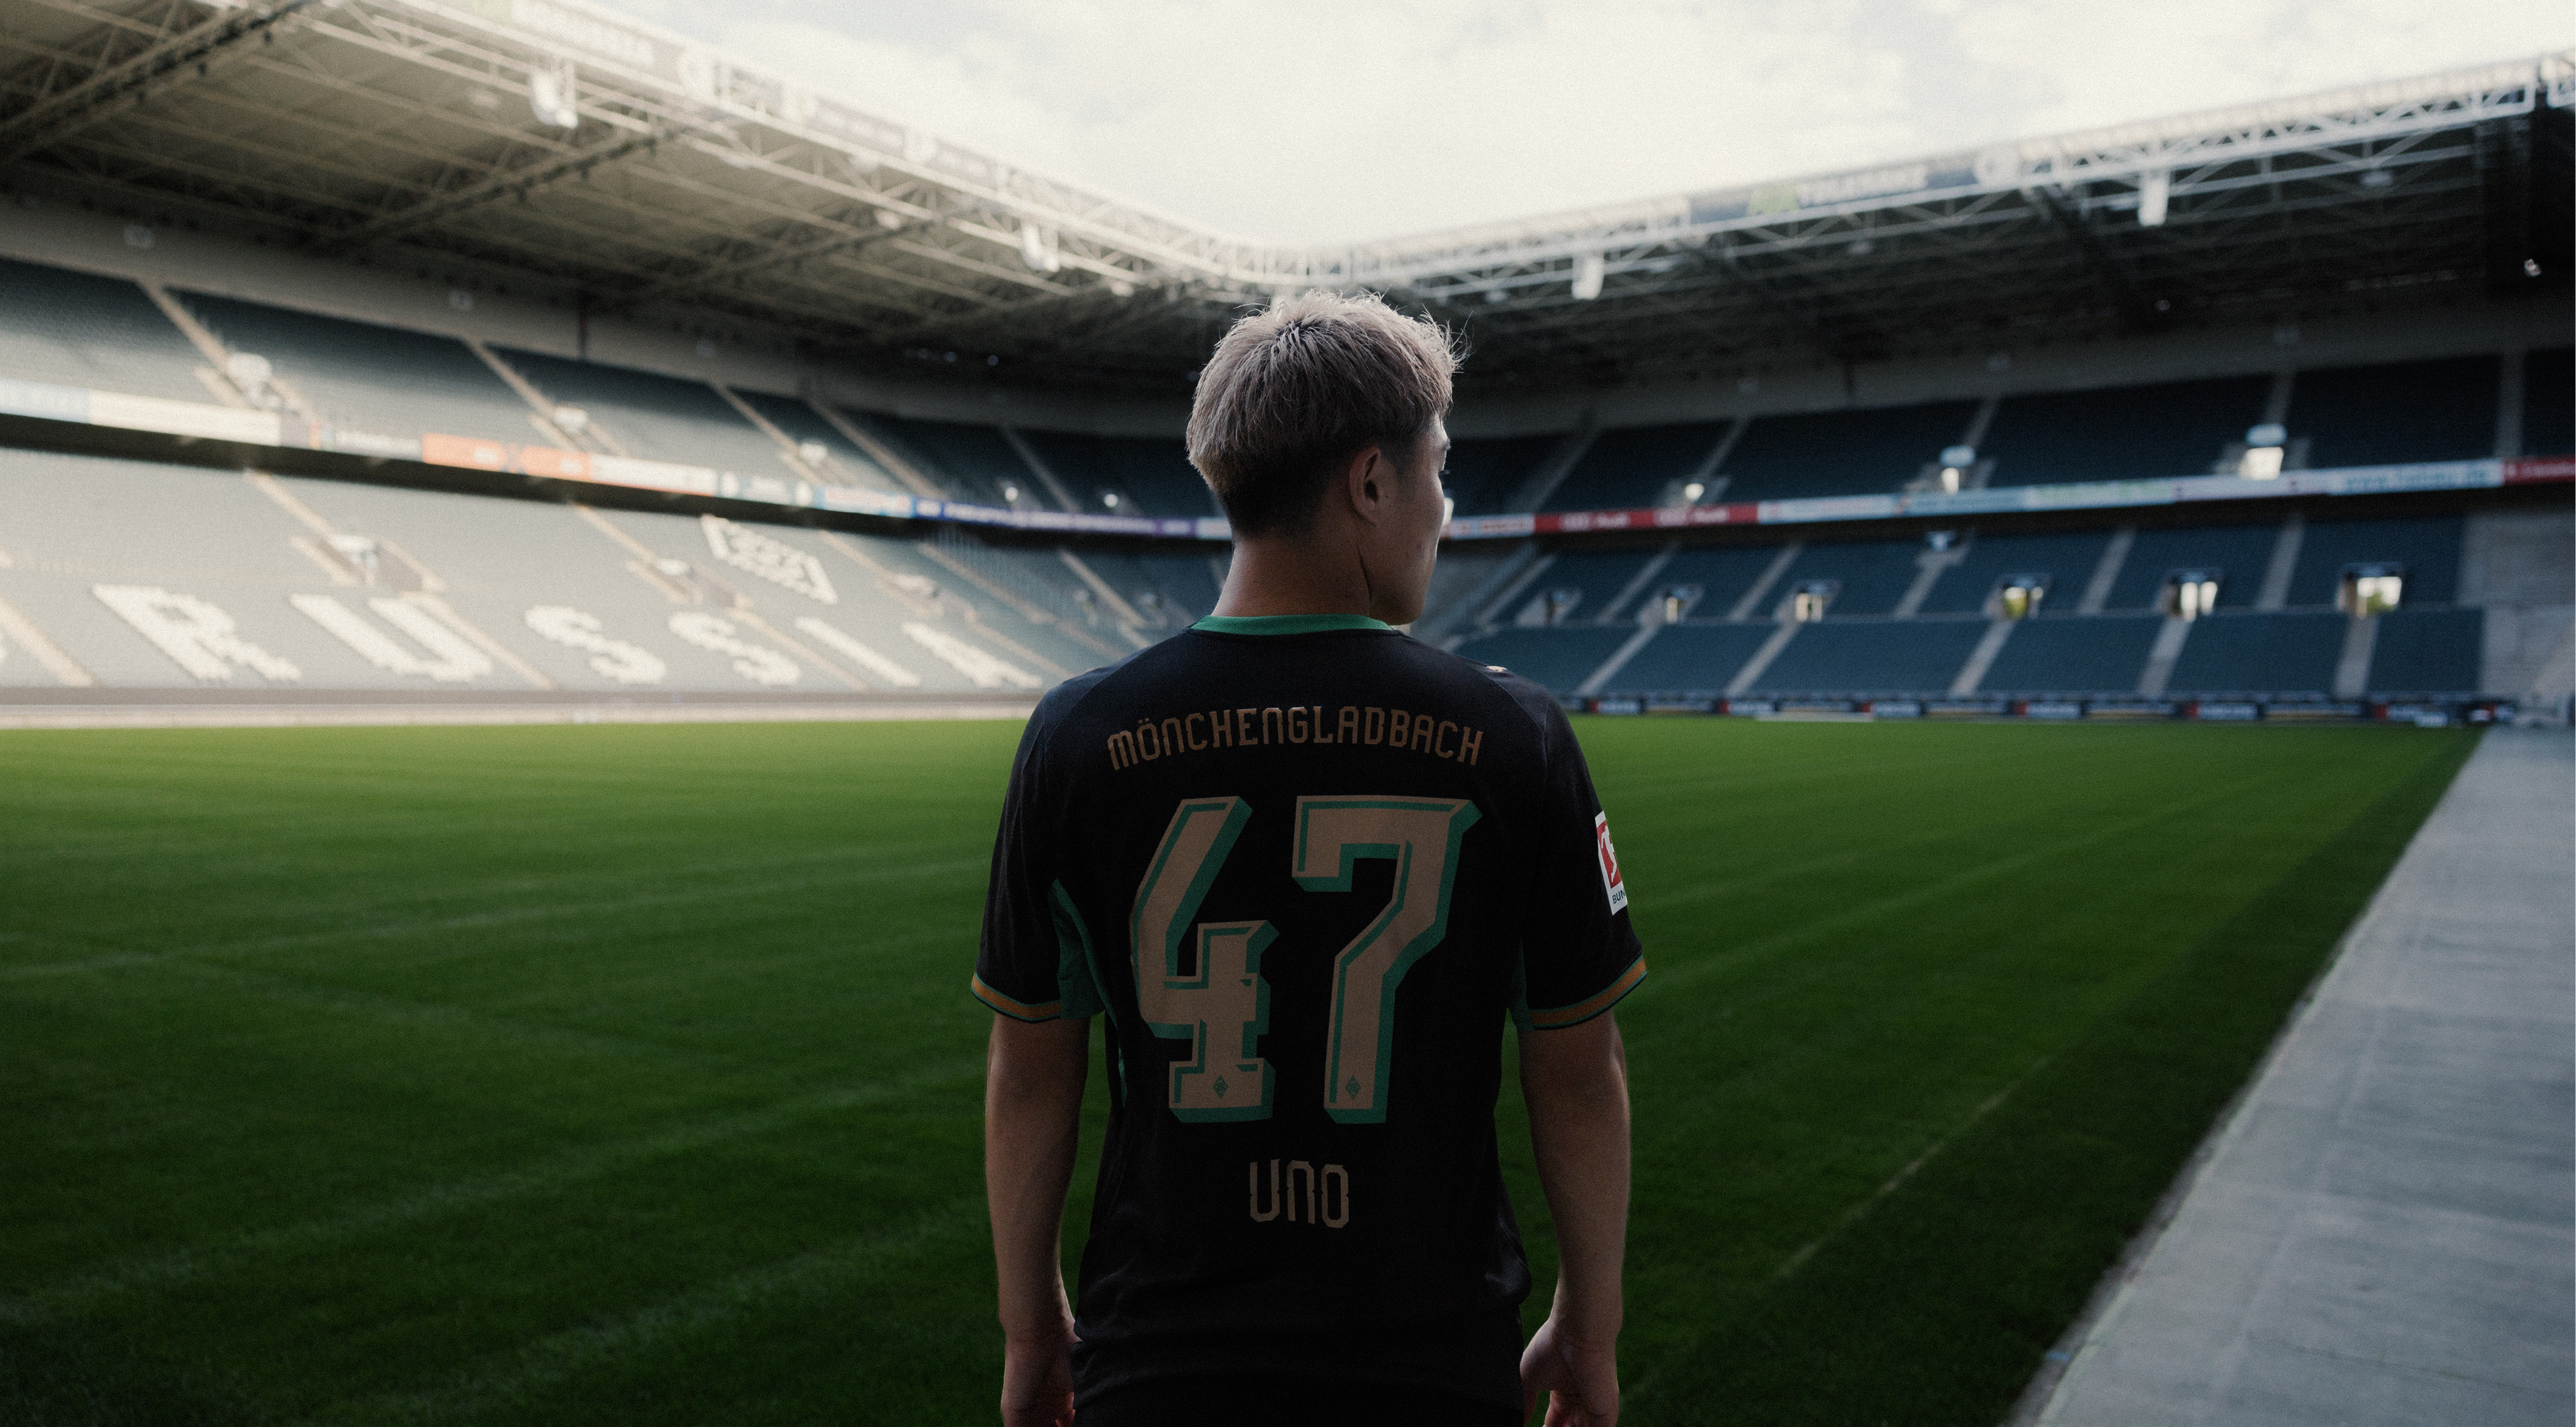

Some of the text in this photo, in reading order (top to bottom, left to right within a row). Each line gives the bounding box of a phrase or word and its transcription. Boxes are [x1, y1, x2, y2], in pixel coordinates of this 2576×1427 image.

[0, 585, 1042, 689] RUSSIA
[1107, 706, 1484, 771] MÖNCHENGLADBACH
[1130, 795, 1482, 1124] 47
[1249, 1158, 1350, 1229] UNO
